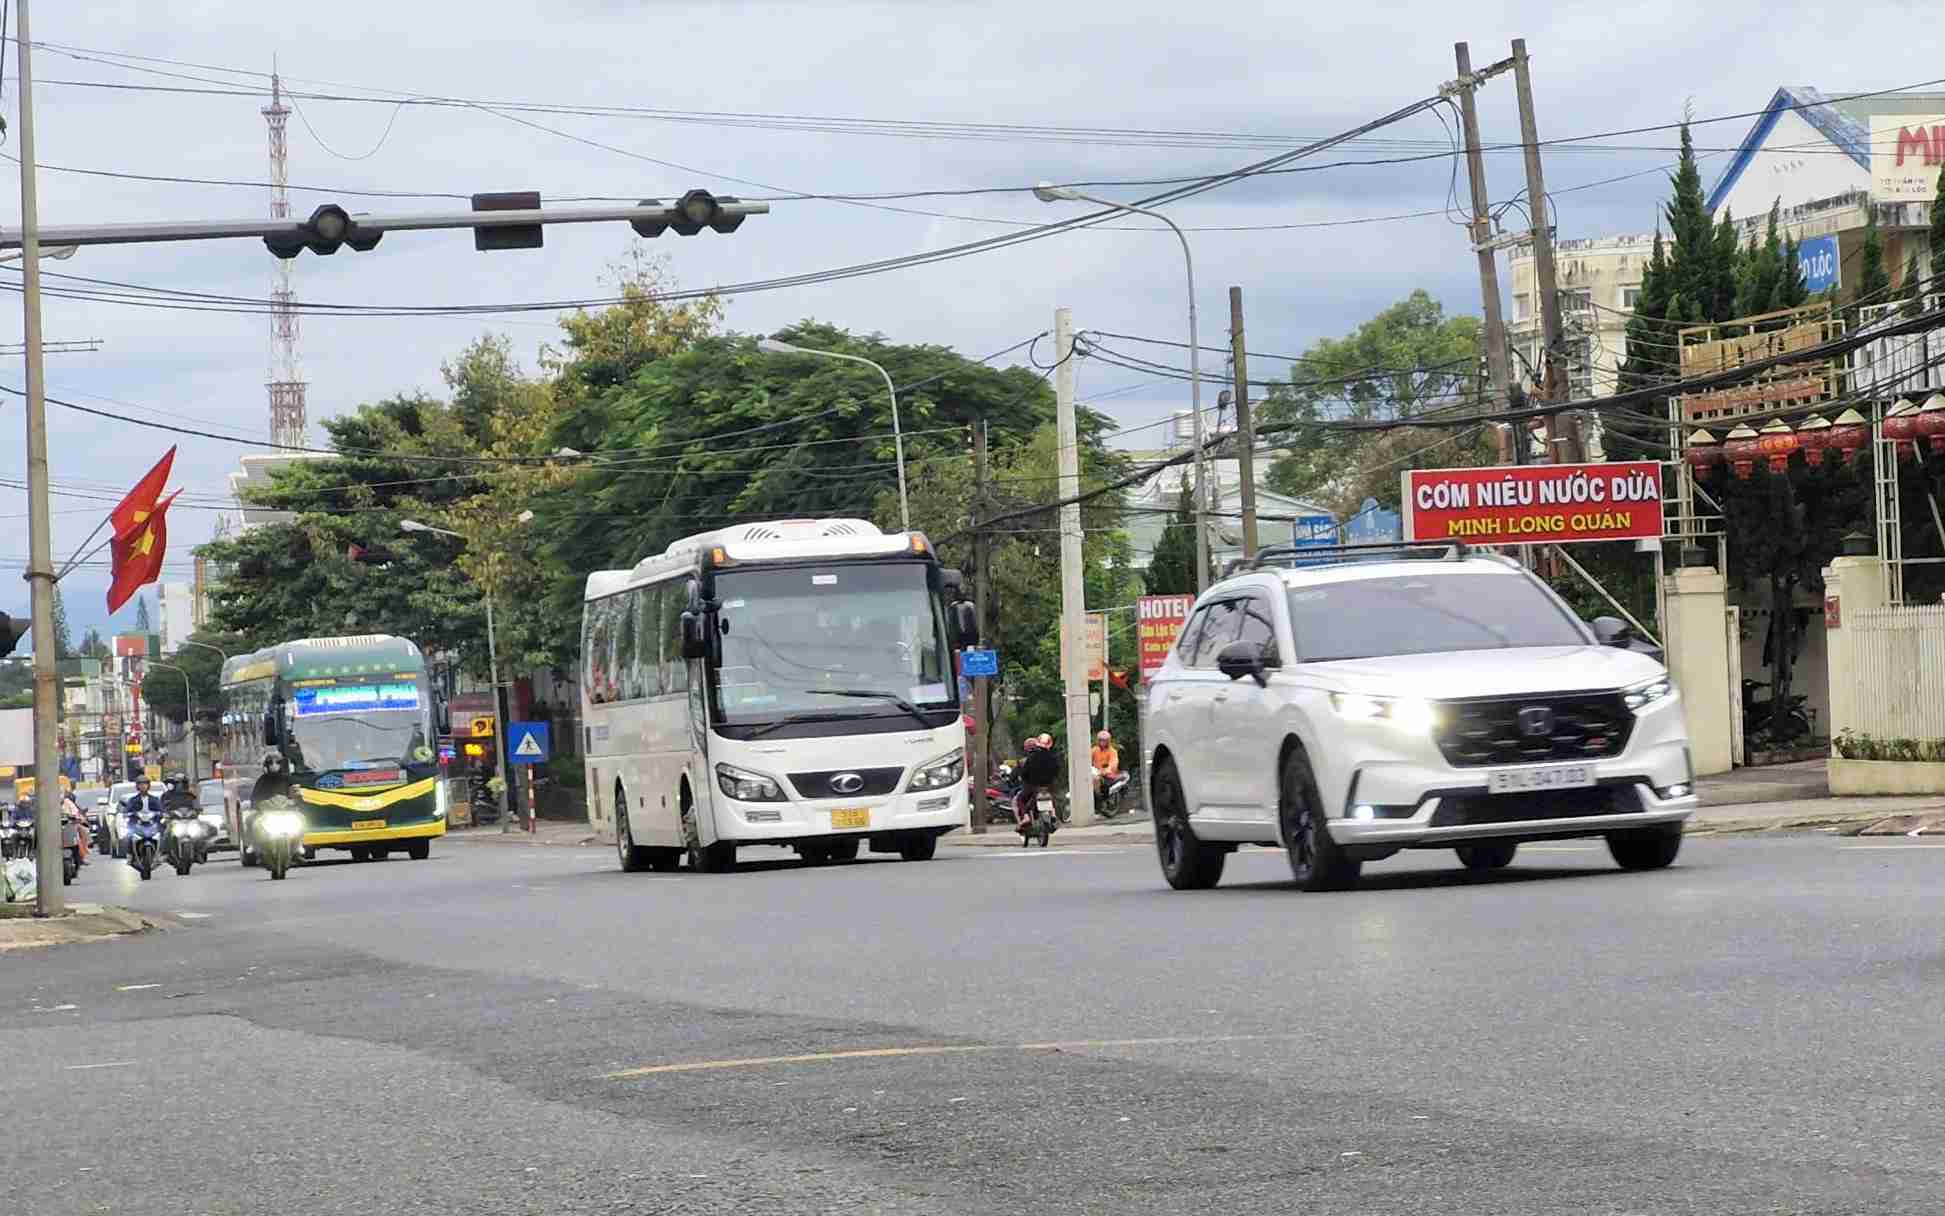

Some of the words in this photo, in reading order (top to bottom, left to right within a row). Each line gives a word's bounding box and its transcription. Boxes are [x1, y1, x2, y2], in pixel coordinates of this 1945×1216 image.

[1416, 479, 1469, 510] CƠM
[1477, 476, 1532, 506] NIÊU
[1539, 470, 1605, 503] NƯỚC
[1611, 470, 1659, 501] DỪA
[1448, 518, 1501, 536] MINH
[1508, 515, 1565, 534] LONG
[1571, 508, 1631, 531] QUÁN
